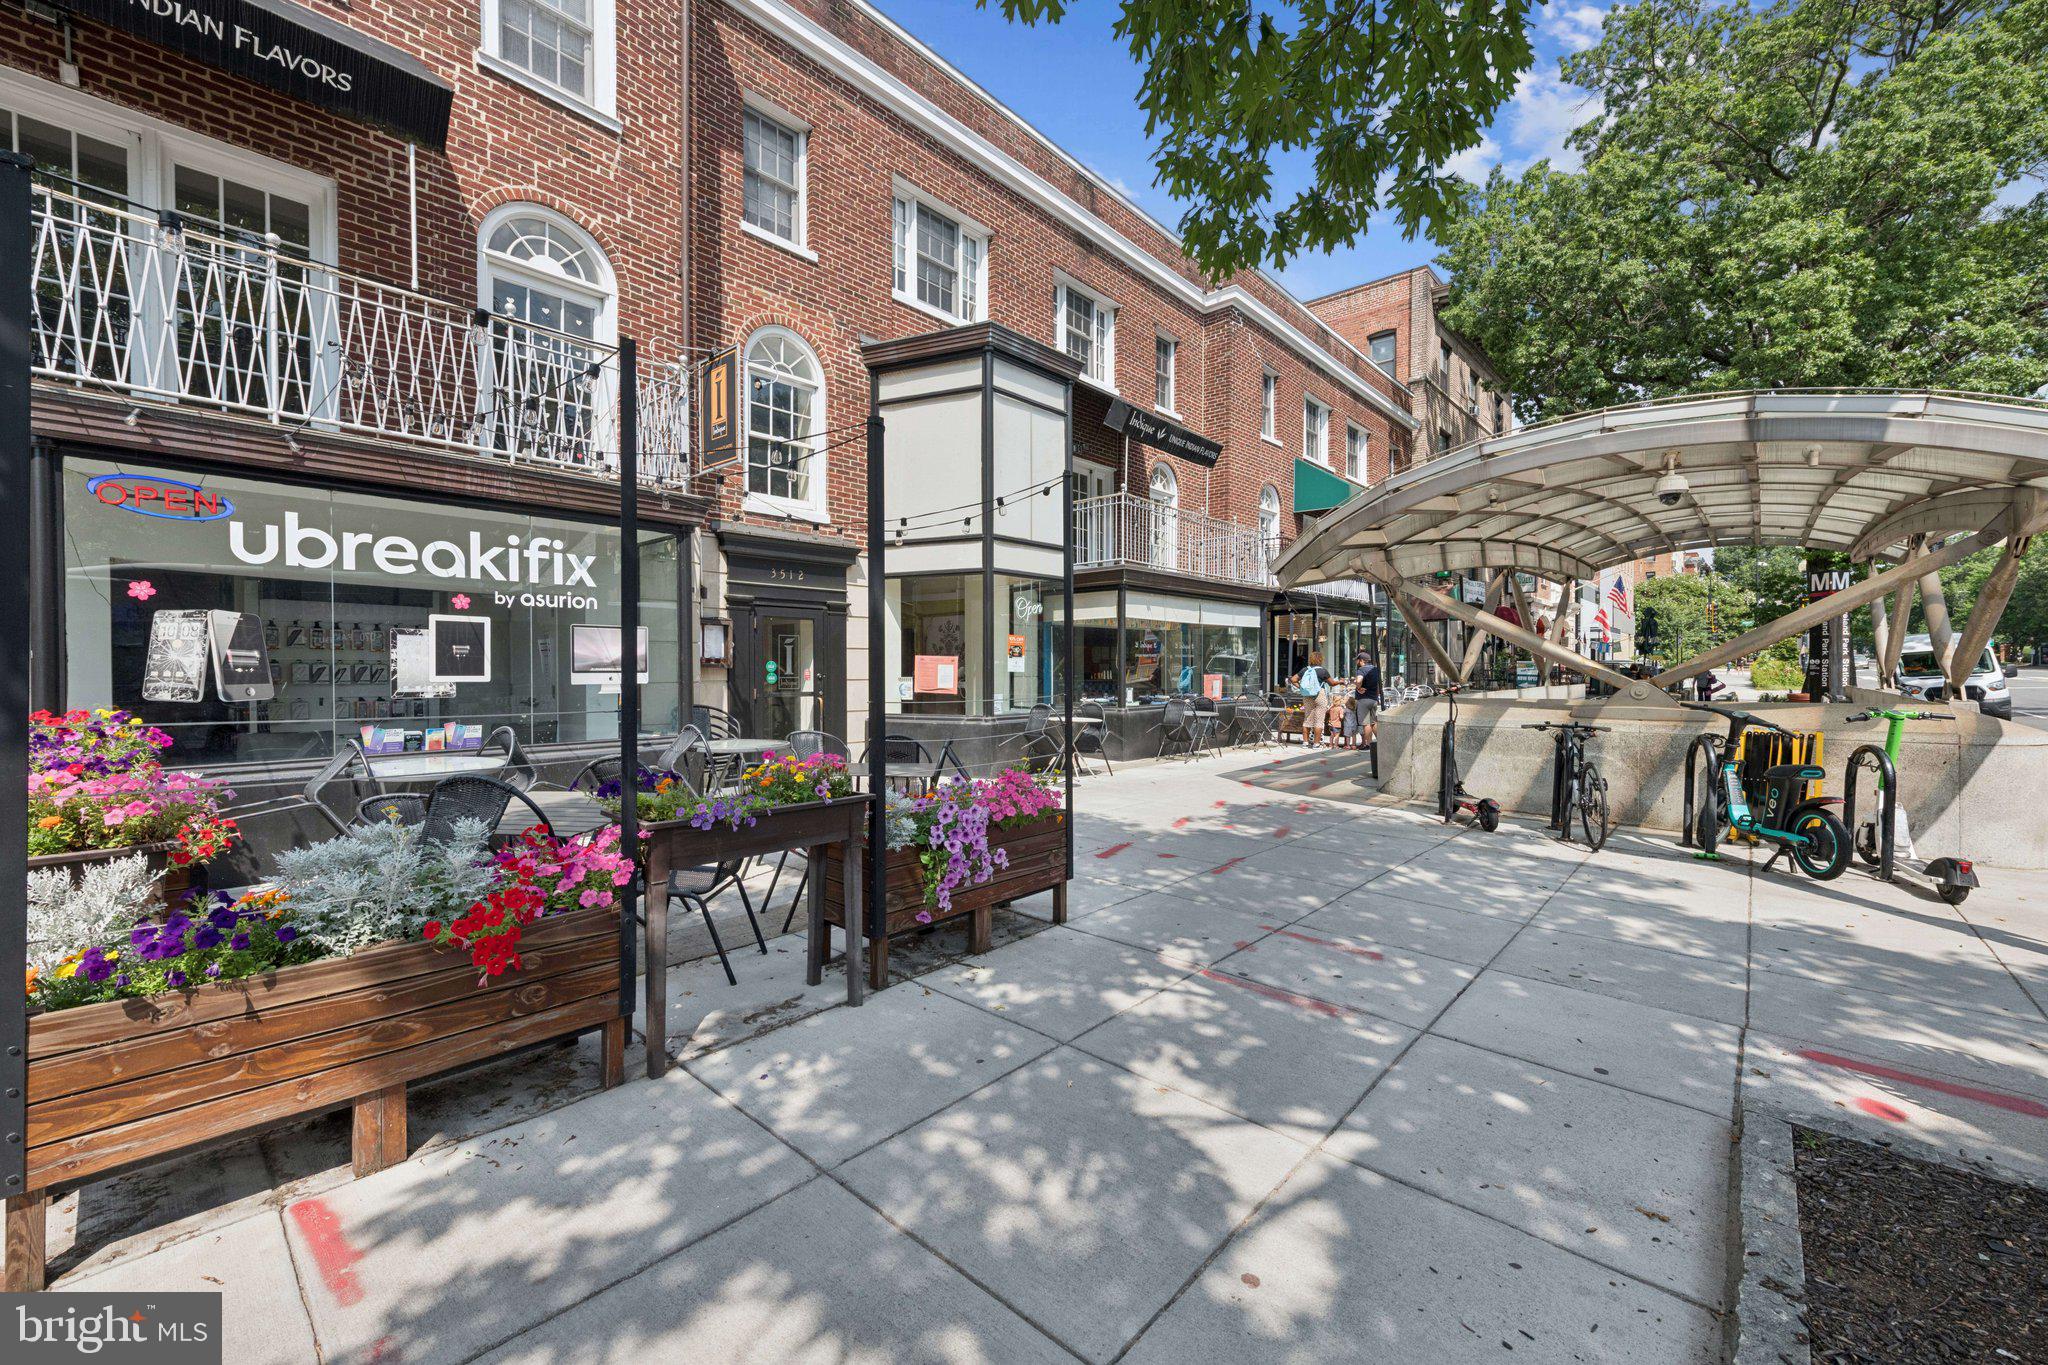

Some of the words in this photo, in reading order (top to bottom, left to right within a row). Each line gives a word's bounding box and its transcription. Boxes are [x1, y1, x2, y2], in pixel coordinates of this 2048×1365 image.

[233, 23, 353, 92] FLAVORS
[1129, 411, 1156, 437] Indique
[96, 483, 217, 514] OPEN
[229, 511, 598, 588] ubreakifix
[770, 567, 804, 580] 3512
[1810, 573, 1829, 592] M
[1831, 571, 1850, 590] M
[494, 591, 516, 609] by
[520, 592, 598, 610] asurion
[1015, 596, 1043, 621] Open
[1842, 611, 1851, 635] eland
[1822, 638, 1830, 656] Park
[1842, 638, 1851, 656] Park
[1821, 658, 1830, 687] Station
[1842, 658, 1850, 687] Station
[1767, 788, 1779, 817] veo
